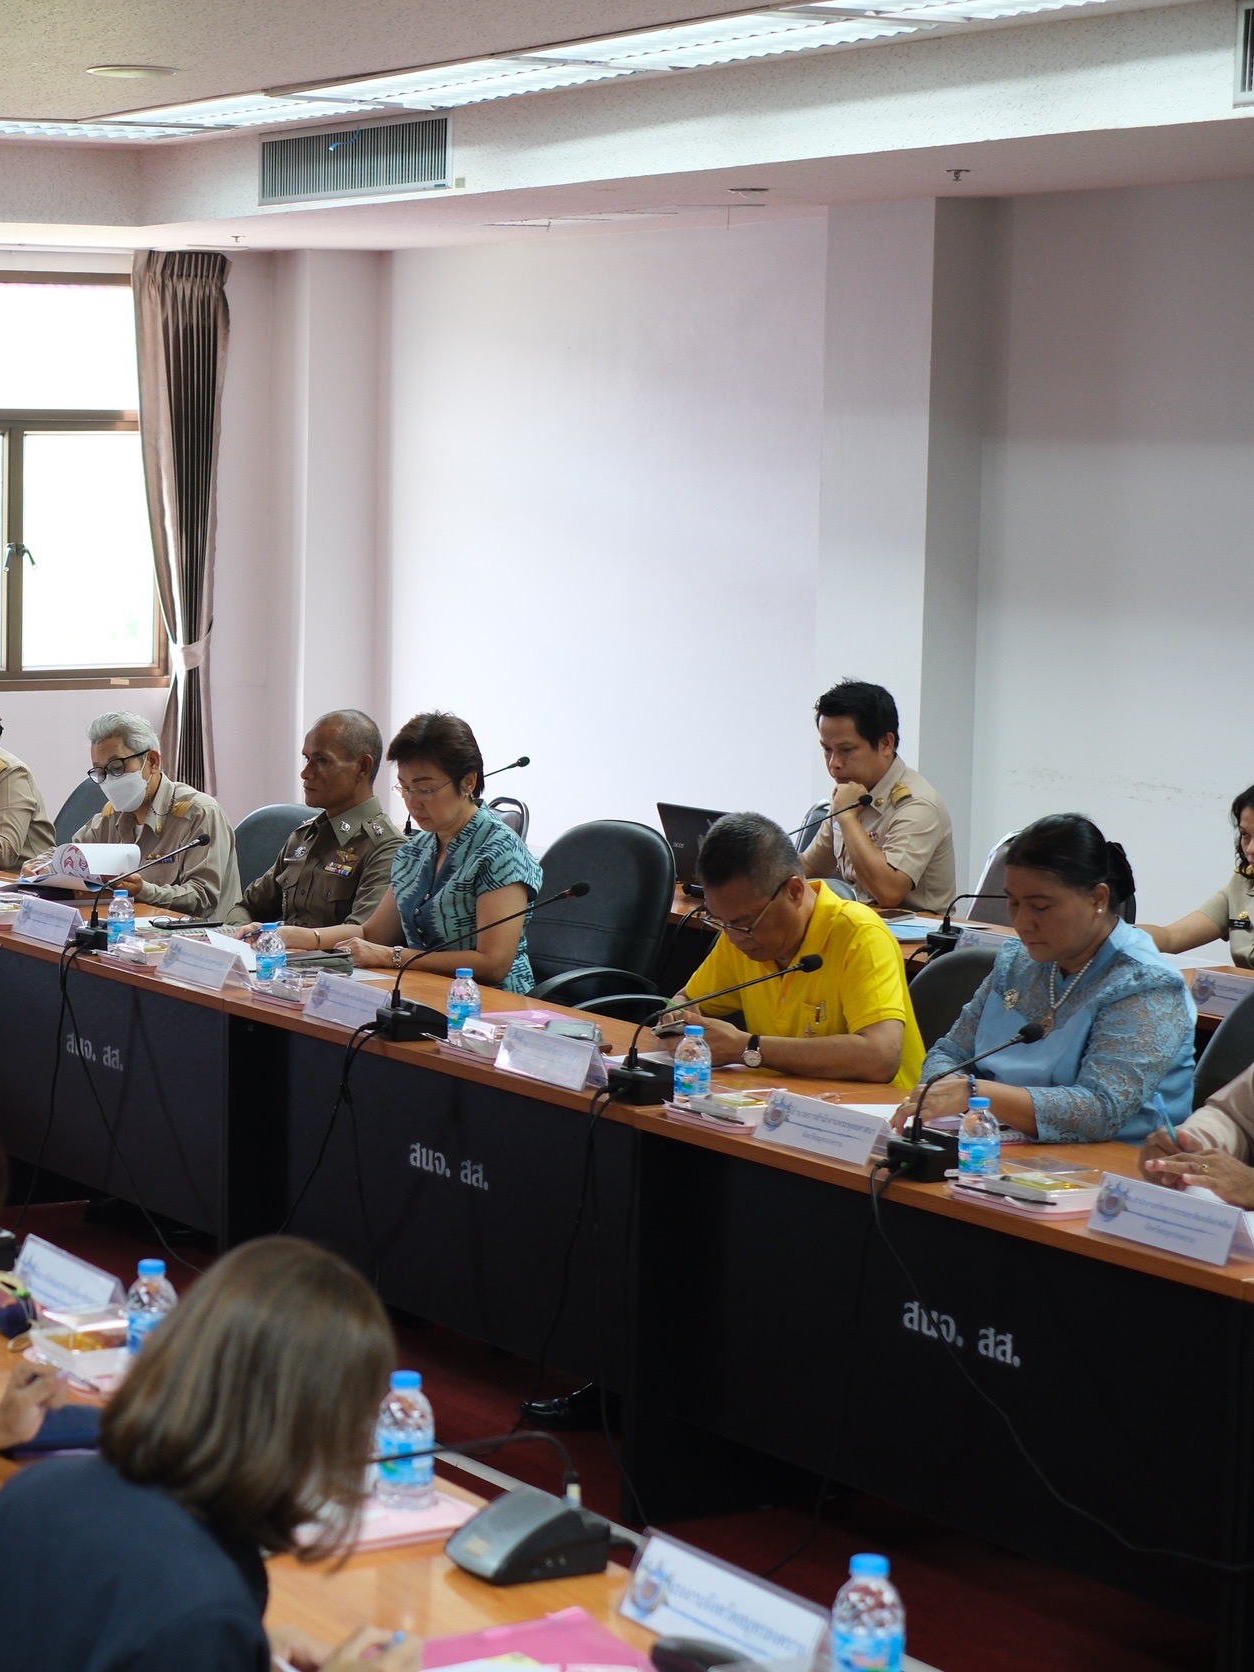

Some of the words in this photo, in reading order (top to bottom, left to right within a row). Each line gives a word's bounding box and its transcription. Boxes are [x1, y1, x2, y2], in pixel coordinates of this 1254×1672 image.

[103, 1046, 123, 1071] สส.
[409, 1143, 451, 1178] สนจ.
[460, 1160, 489, 1191] สส.
[977, 1327, 1020, 1367] สส.
